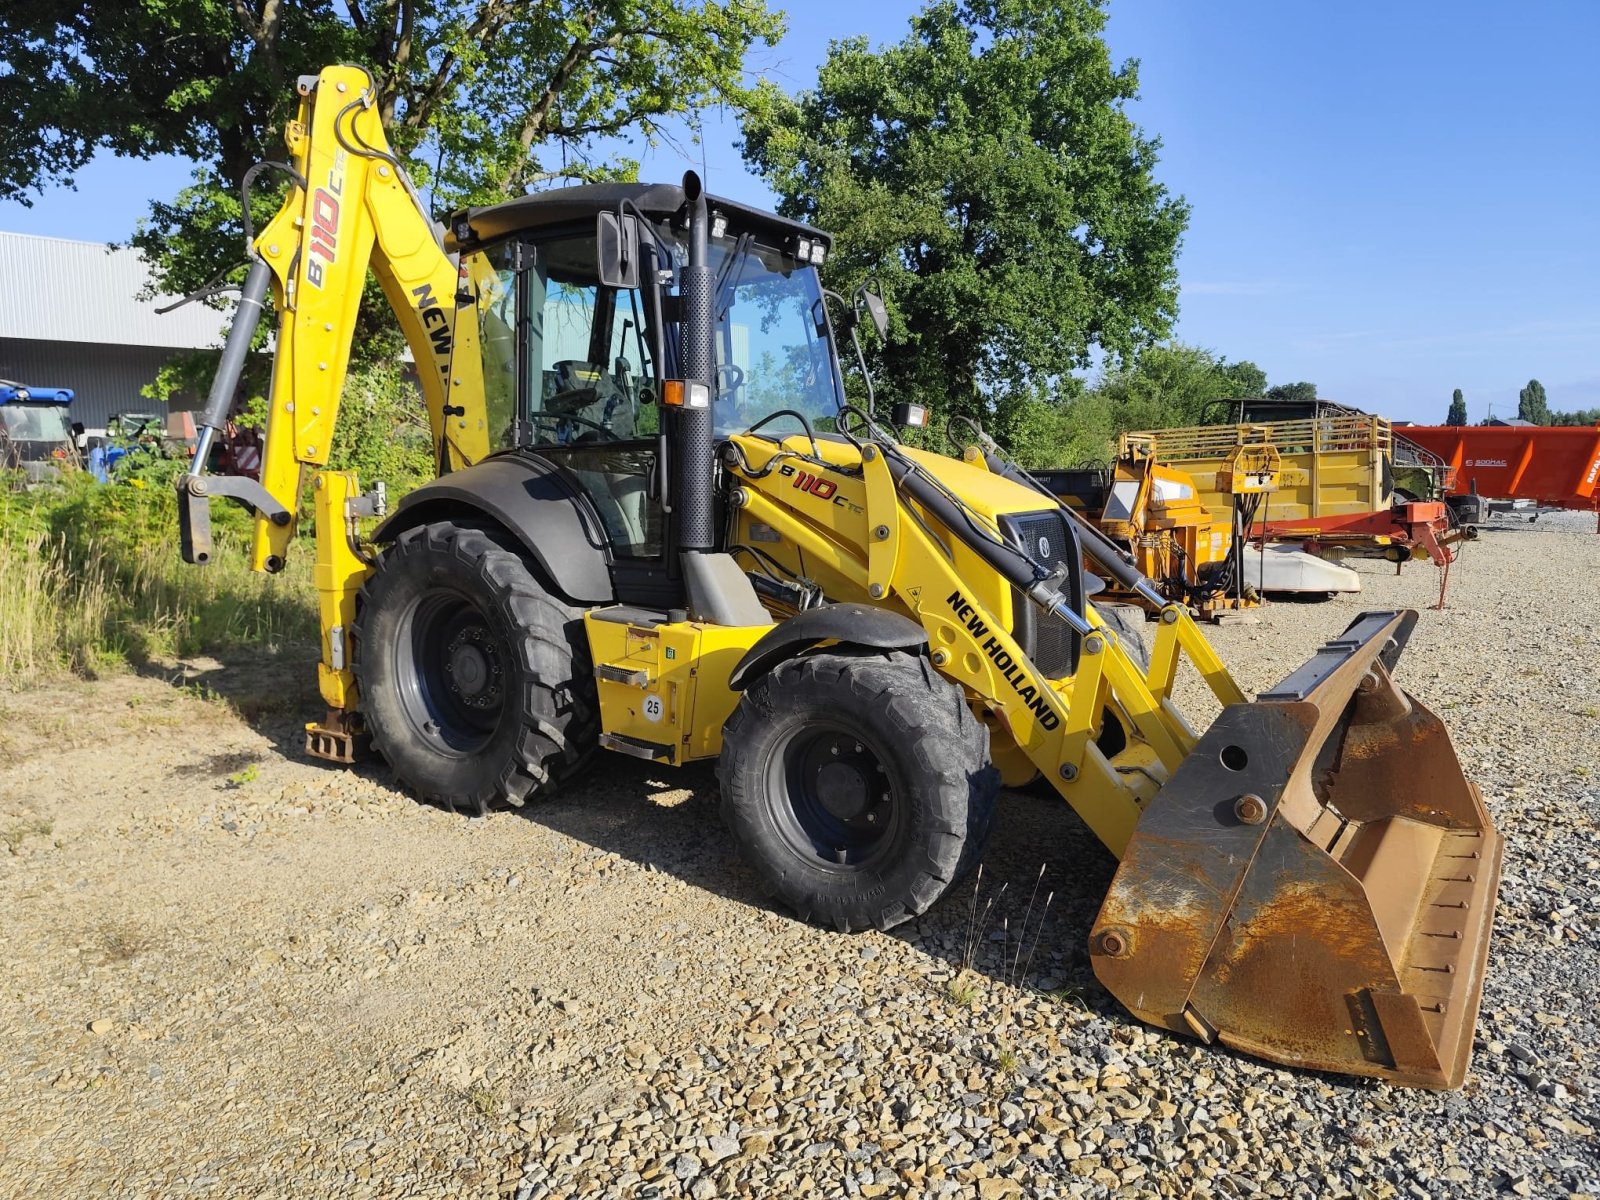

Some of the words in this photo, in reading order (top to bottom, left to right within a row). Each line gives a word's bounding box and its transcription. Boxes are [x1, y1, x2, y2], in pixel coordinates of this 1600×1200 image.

[412, 284, 452, 355] NEW
[946, 591, 989, 639] NEW
[982, 637, 1060, 731] HOLLAND
[647, 700, 659, 715] 25
